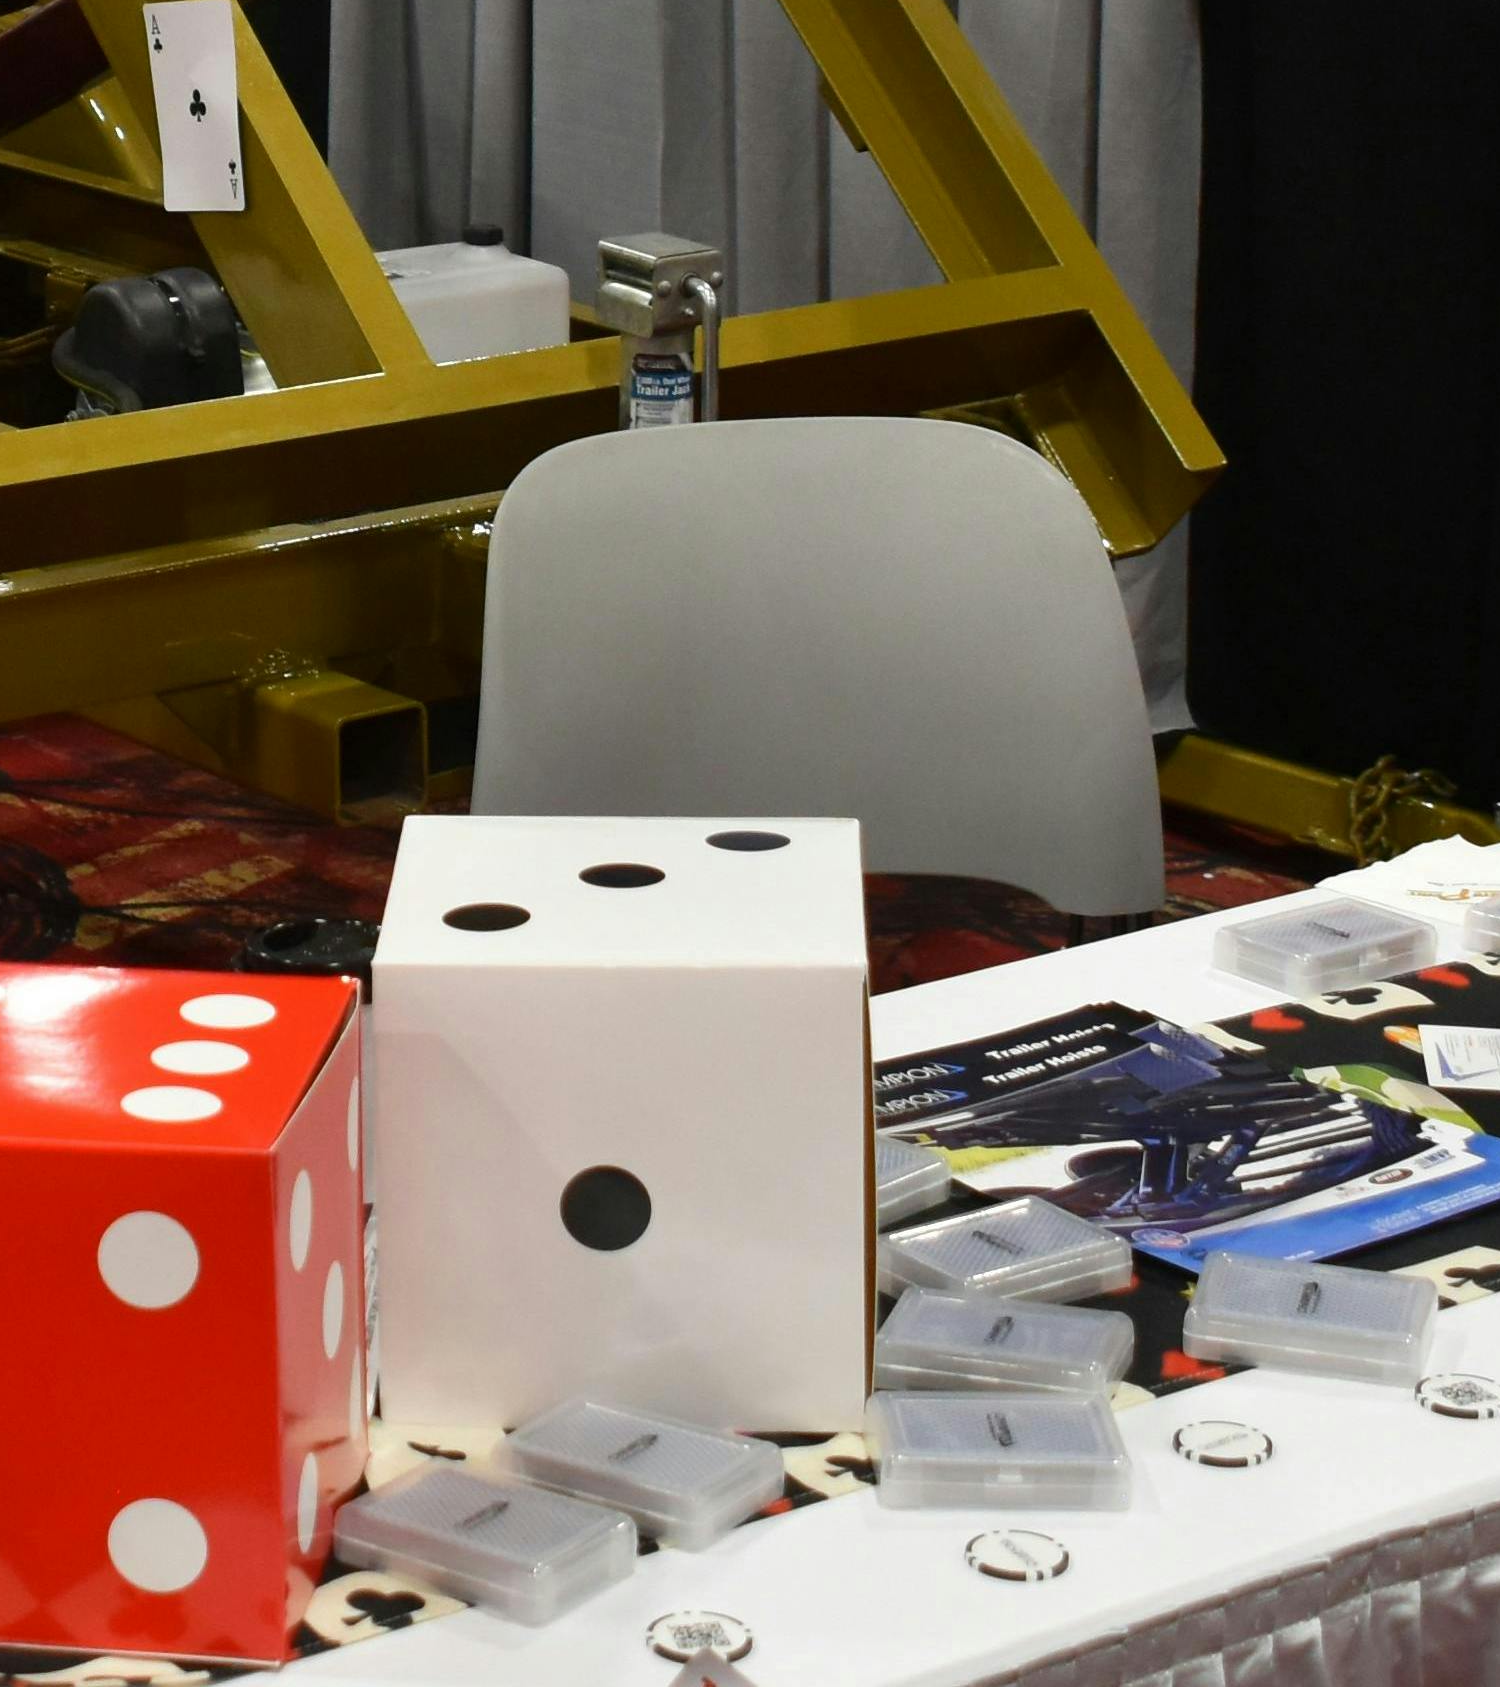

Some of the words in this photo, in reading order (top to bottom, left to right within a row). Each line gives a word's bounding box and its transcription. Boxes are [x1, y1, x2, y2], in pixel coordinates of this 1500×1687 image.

[151, 14, 161, 35] A
[229, 178, 238, 199] A
[636, 383, 670, 396] Trailer
[984, 1039, 1051, 1060] Trailer
[982, 1060, 1046, 1085] Trailer
[1046, 1044, 1107, 1068] Hoists
